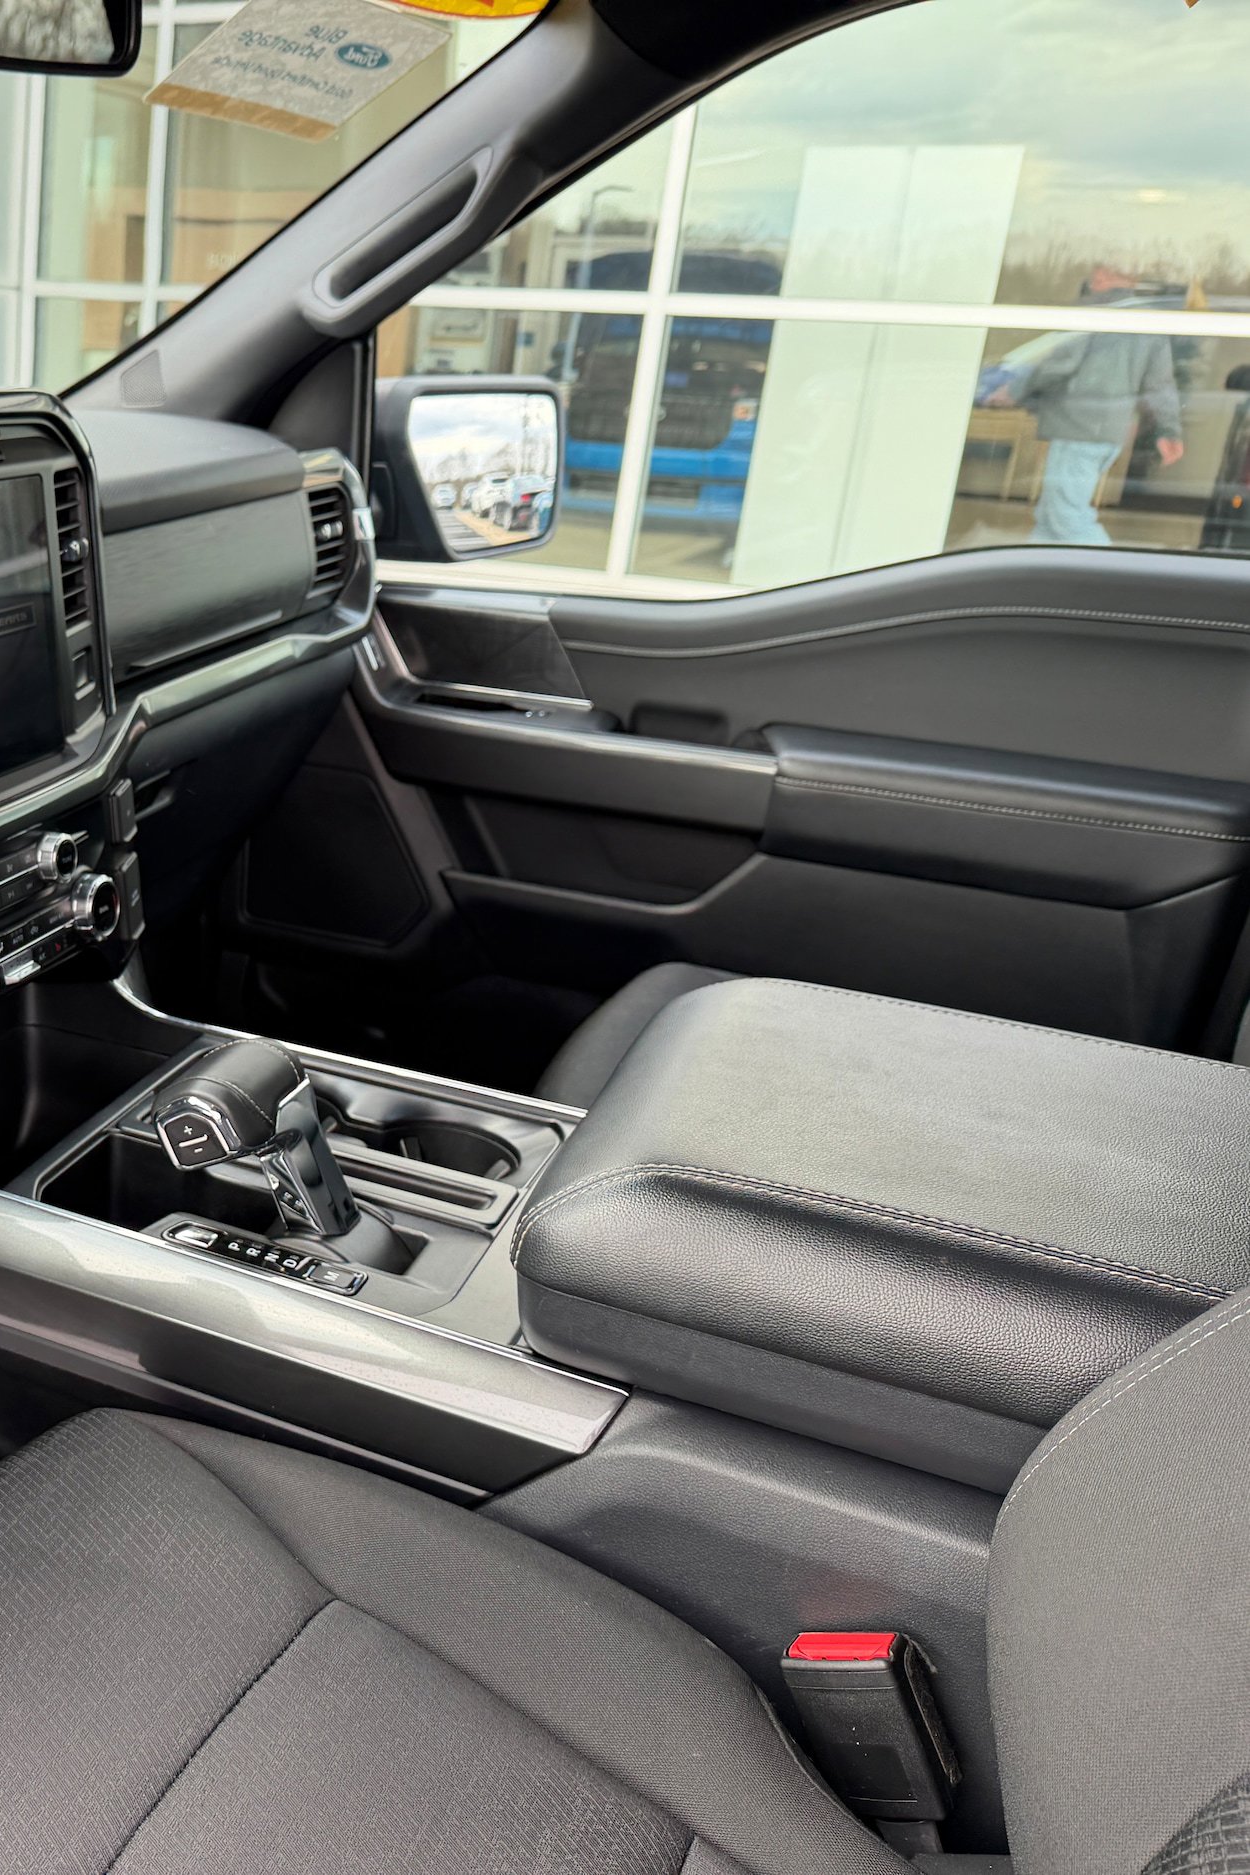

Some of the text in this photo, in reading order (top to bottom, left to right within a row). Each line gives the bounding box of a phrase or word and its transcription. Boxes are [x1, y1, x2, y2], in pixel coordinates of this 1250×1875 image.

[228, 1242, 298, 1268] P R N D
[323, 1271, 340, 1281] M
